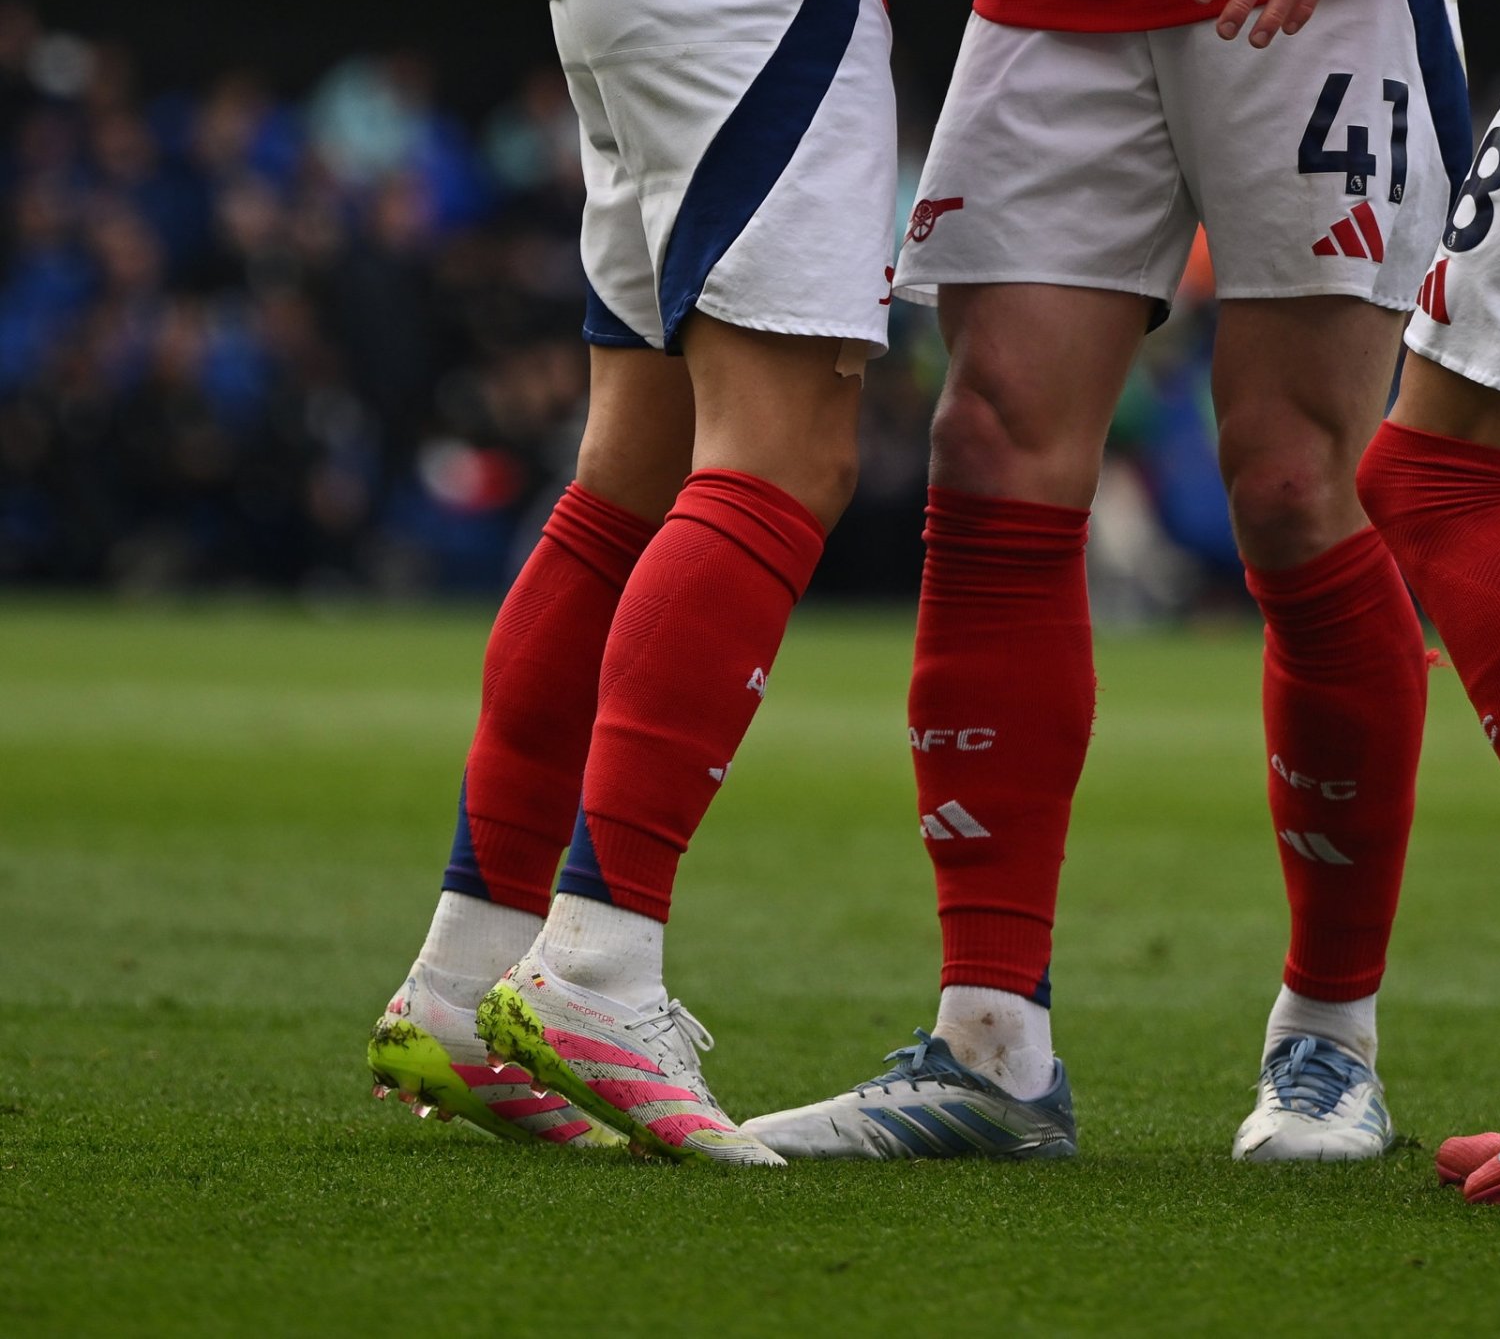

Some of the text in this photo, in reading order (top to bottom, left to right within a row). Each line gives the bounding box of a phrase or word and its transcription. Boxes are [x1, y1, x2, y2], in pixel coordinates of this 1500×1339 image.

[1298, 73, 1408, 205] 41
[908, 727, 996, 752] AFC
[1271, 754, 1357, 800] AFC
[566, 1001, 615, 1027] PREDATOR
